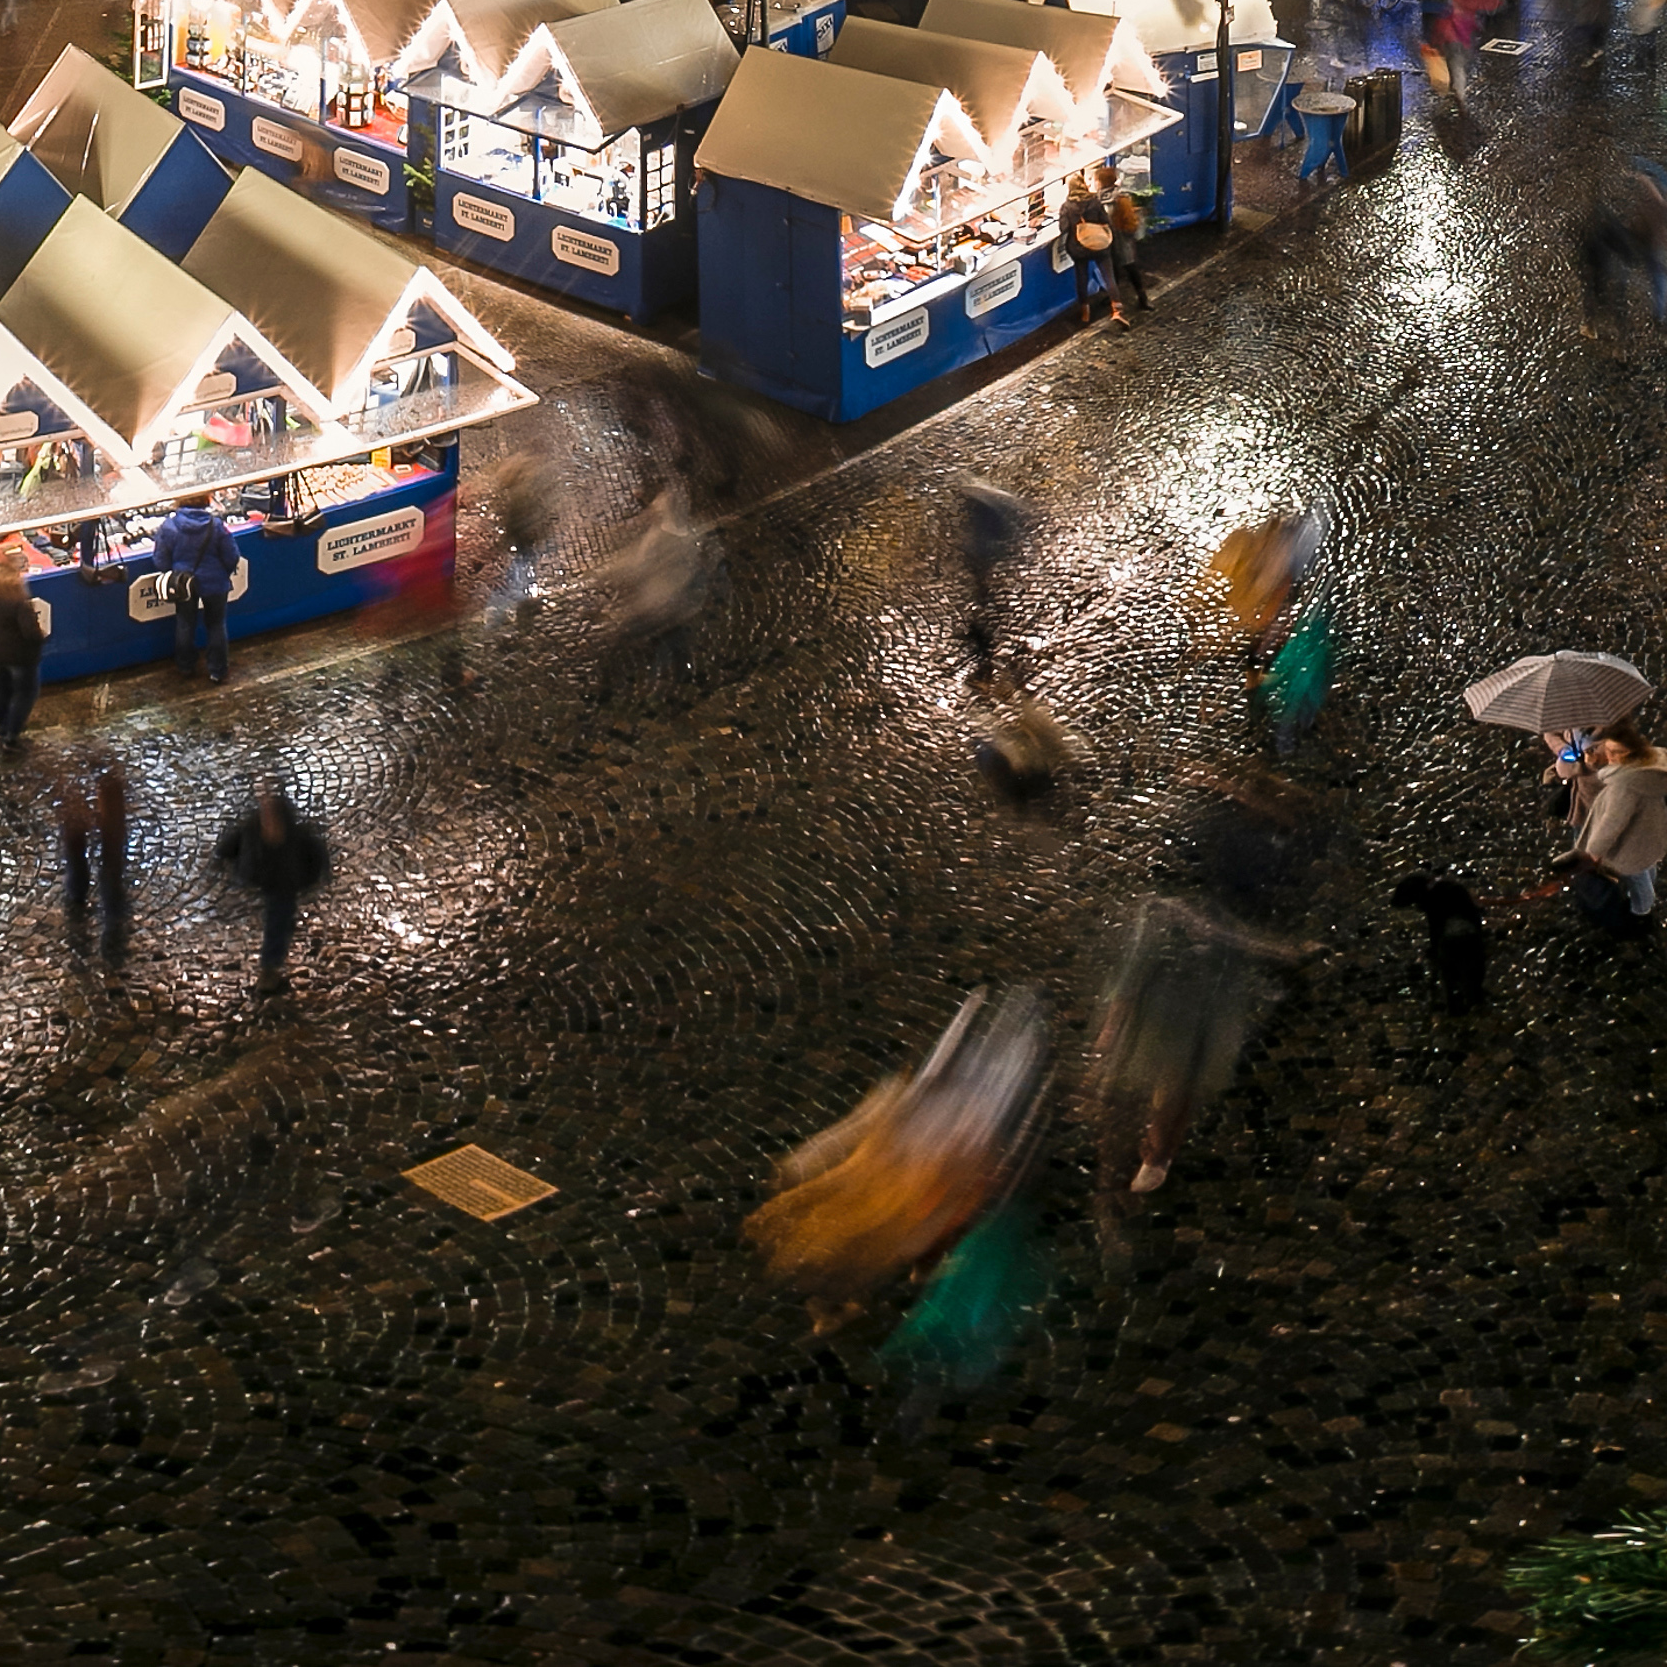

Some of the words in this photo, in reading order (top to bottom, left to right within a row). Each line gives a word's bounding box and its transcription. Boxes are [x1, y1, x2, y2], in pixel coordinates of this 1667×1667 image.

[327, 518, 417, 551] LICHTERMARKT
[332, 550, 351, 562] ST.
[353, 532, 412, 556] LAMBERTI
